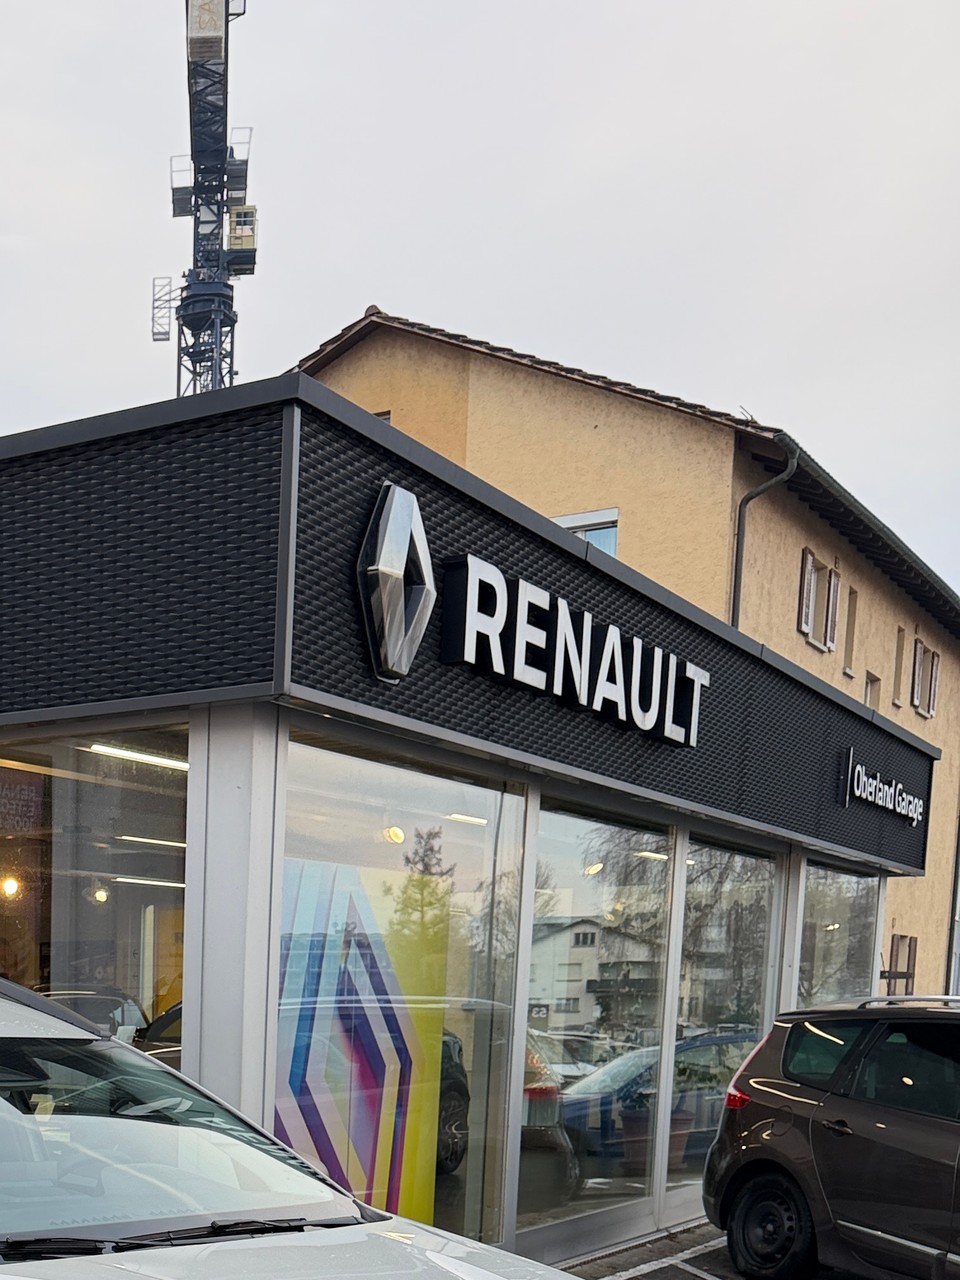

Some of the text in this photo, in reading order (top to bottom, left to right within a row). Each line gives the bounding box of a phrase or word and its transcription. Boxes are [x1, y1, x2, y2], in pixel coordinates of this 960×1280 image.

[463, 553, 710, 748] RENAULT
[853, 764, 923, 828] Oberland Garage
